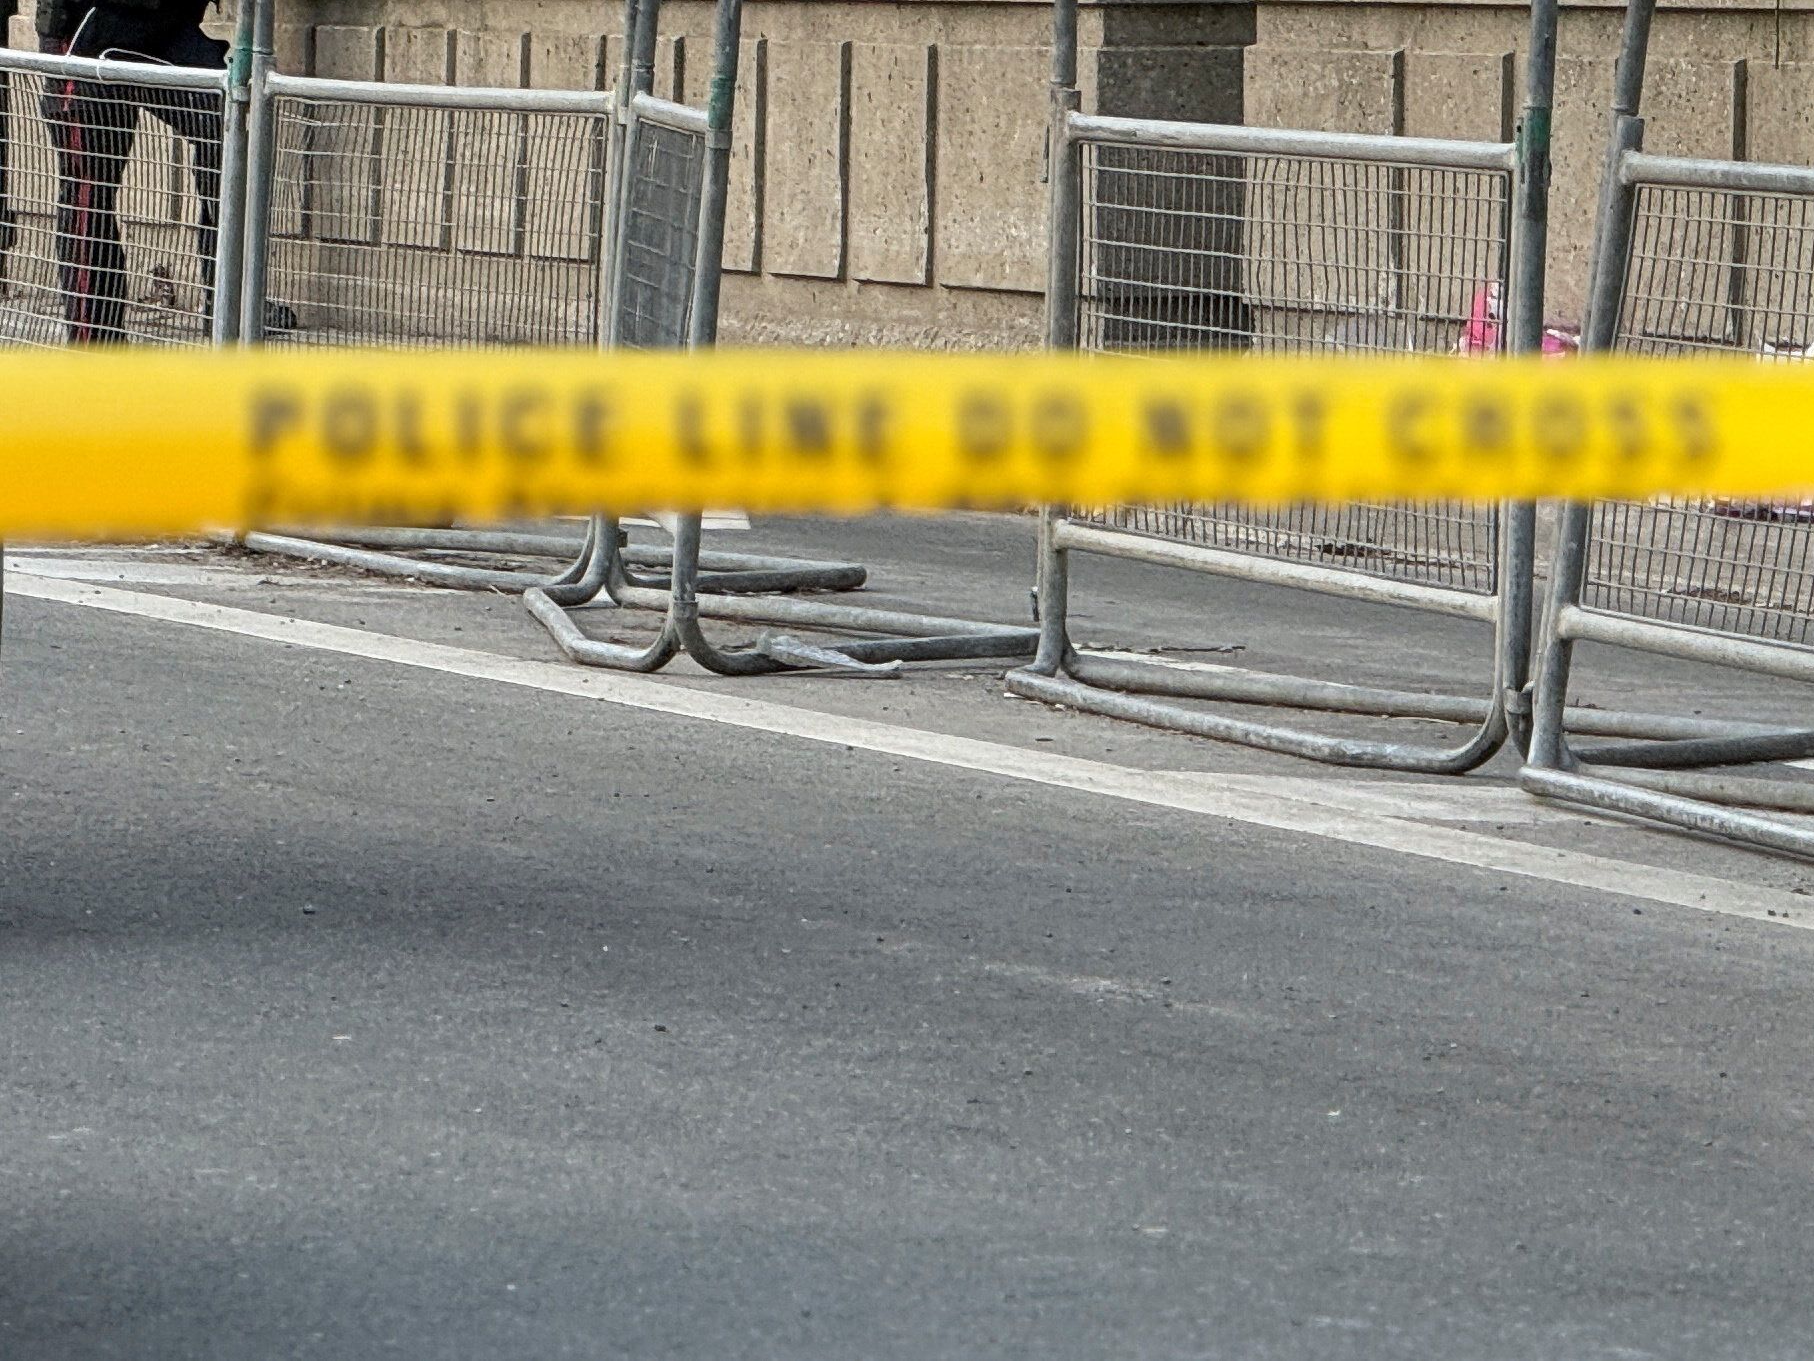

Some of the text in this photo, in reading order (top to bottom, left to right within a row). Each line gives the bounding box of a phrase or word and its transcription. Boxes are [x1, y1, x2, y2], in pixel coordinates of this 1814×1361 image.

[248, 381, 1722, 469] POLICE LINE DO NOT CROSS
